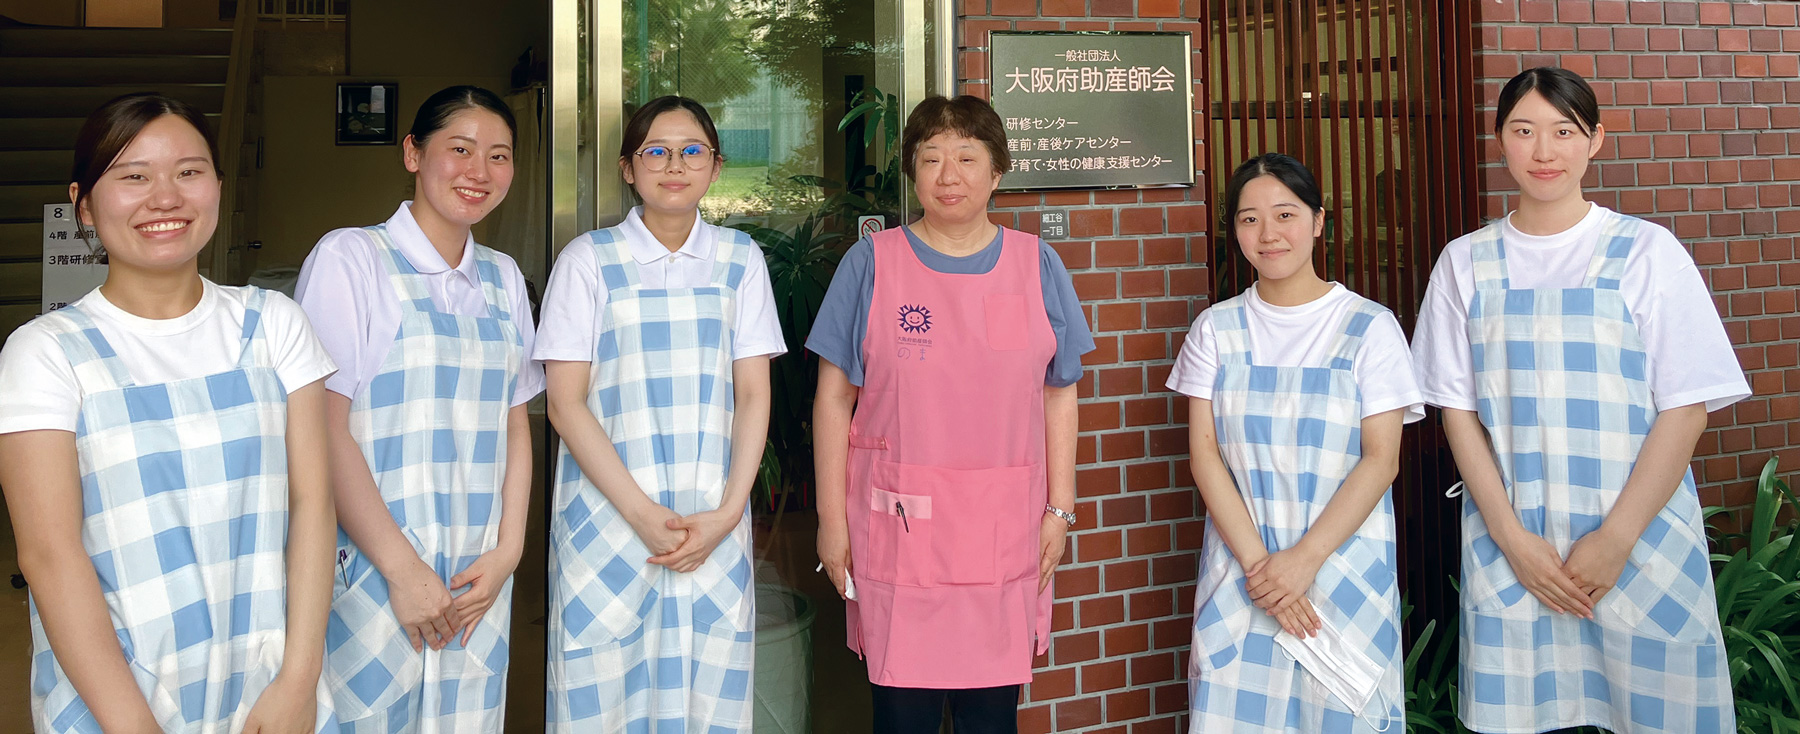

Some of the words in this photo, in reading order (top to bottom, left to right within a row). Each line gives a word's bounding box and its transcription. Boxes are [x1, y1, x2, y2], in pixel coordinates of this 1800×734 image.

[1055, 50, 1121, 62] 一般社団法人
[1005, 66, 1175, 93] 大阪府助産師会
[1006, 117, 1078, 131] 研修センター
[1007, 136, 1132, 152] 産前・産後ケアセンター
[1008, 155, 1172, 172] 子育て・女性の健康支援センター
[1042, 213, 1063, 223] 細工谷
[49, 231, 67, 240] 4階
[1042, 226, 1063, 236] 一丁目
